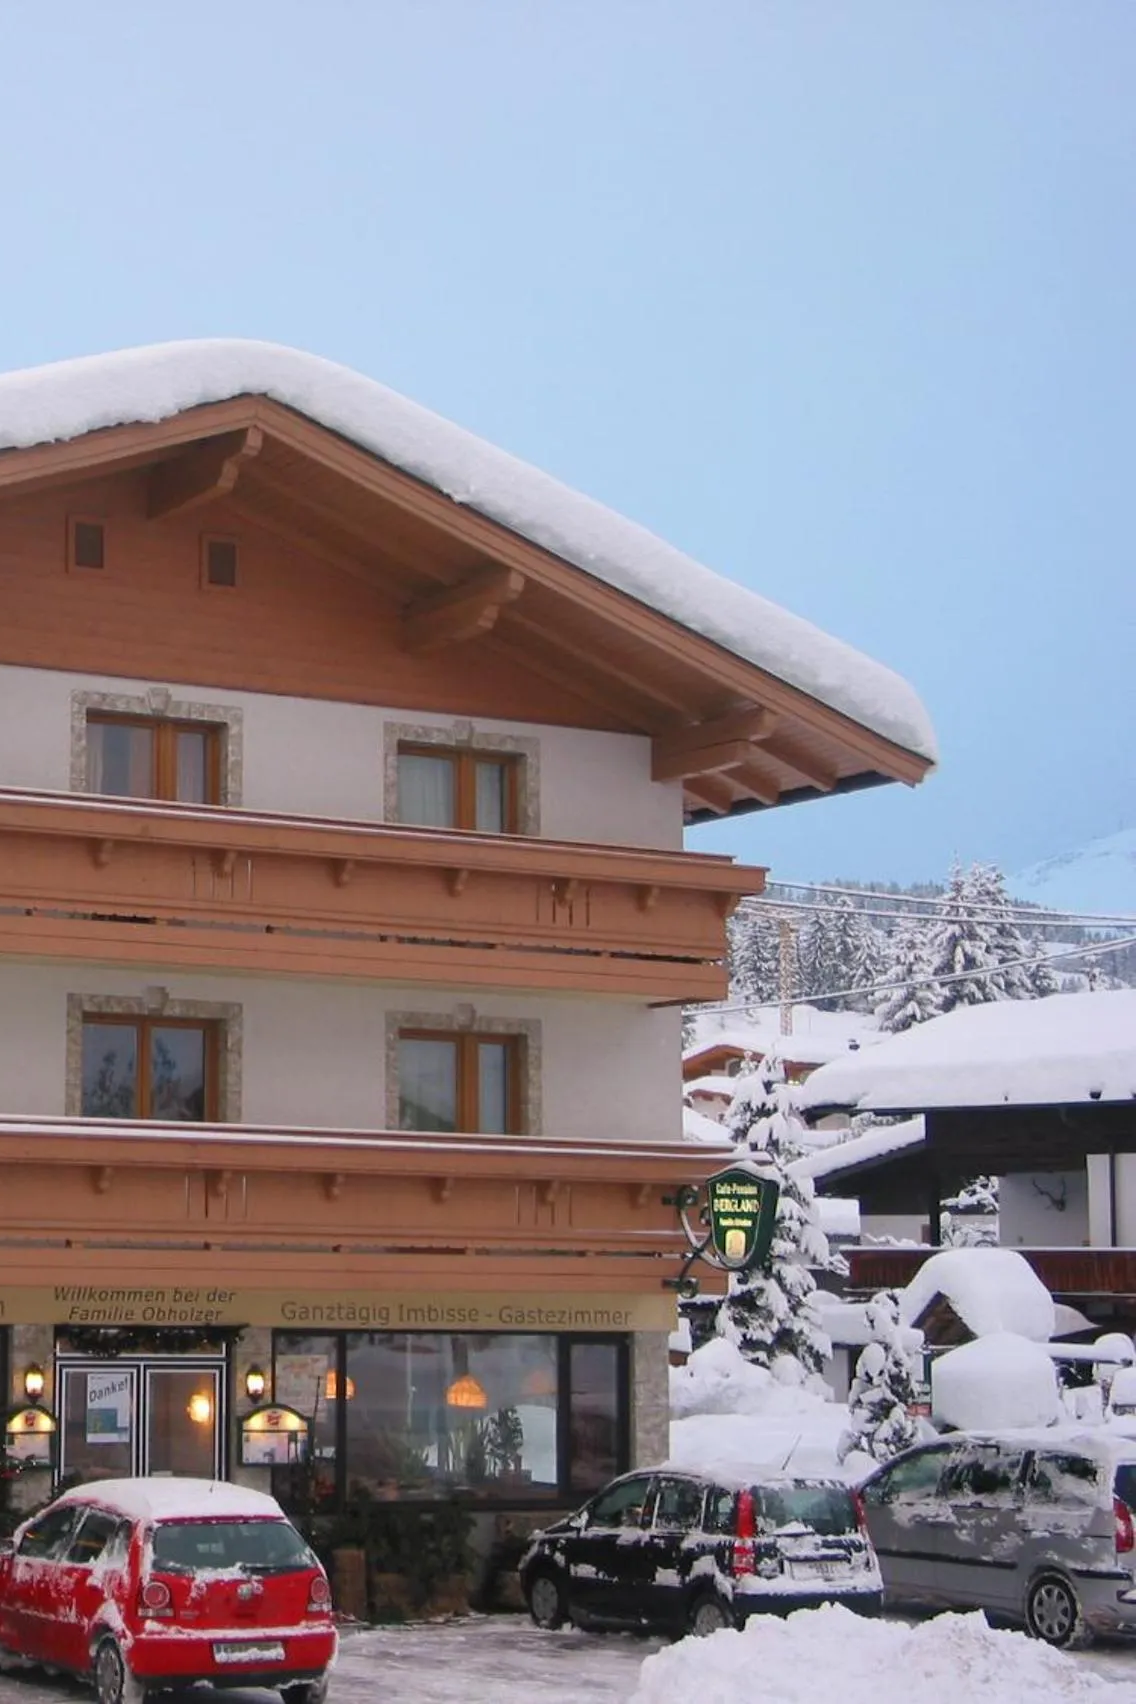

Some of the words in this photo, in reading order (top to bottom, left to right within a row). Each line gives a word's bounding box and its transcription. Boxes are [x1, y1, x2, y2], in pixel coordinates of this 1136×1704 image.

[713, 1198, 760, 1213] BERGLAND
[54, 1286, 165, 1302] Willkommen
[173, 1287, 200, 1303] bei
[207, 1287, 236, 1303] der
[69, 1306, 135, 1321] Familie
[142, 1306, 224, 1322] Obholzer
[398, 1303, 479, 1322] Imbisse
